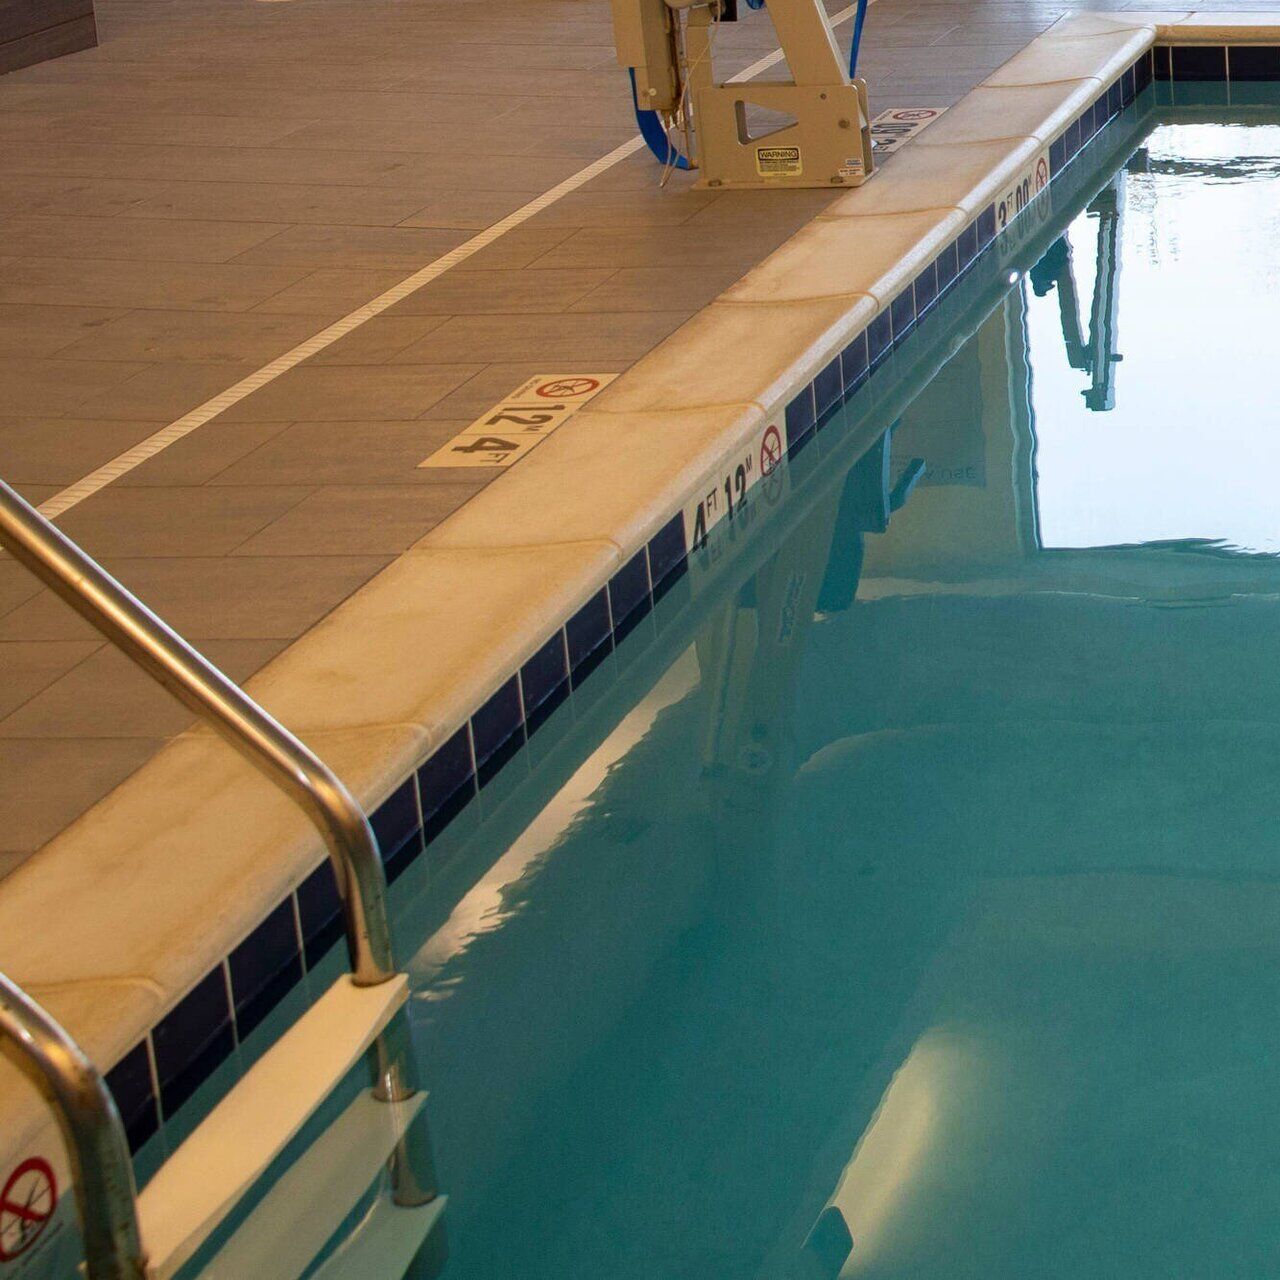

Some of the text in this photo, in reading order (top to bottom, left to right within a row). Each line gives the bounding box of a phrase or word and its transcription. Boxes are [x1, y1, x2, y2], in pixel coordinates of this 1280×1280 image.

[760, 150, 797, 158] WARNING
[451, 437, 521, 454] 4
[706, 487, 718, 518] FT
